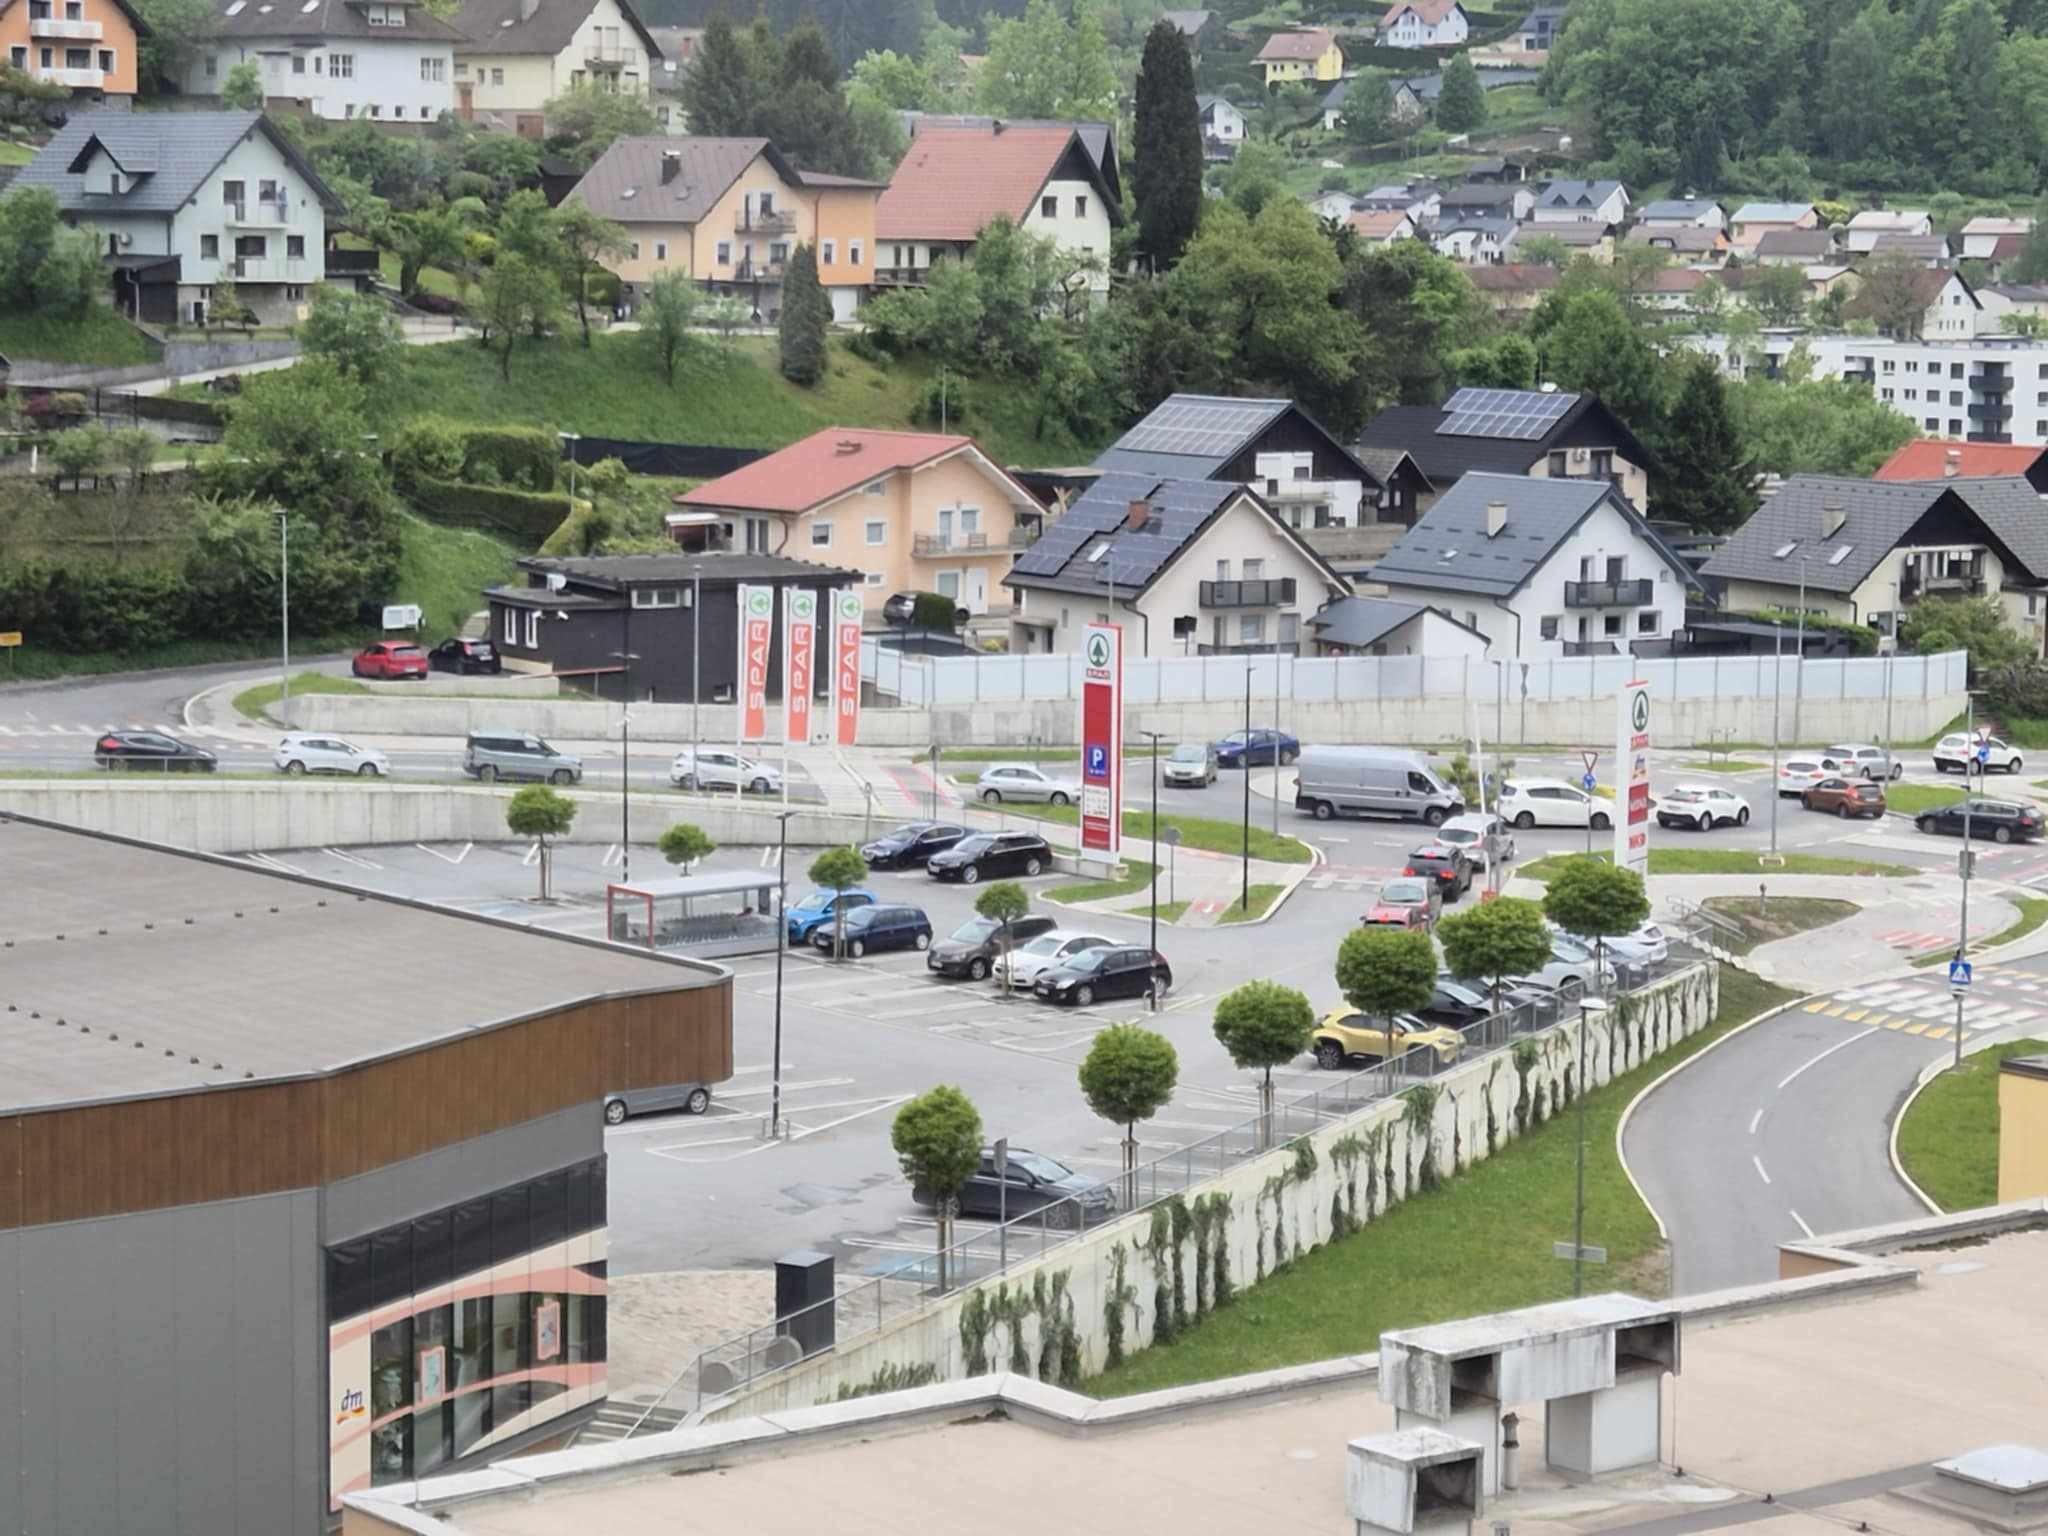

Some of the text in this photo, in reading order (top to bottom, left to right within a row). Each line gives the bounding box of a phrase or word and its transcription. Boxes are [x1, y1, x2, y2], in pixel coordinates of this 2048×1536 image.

[749, 622, 766, 710] SPAR
[792, 626, 809, 714] SPAR
[842, 627, 857, 717] SPAR
[1092, 748, 1103, 768] P
[340, 1388, 363, 1412] dm
